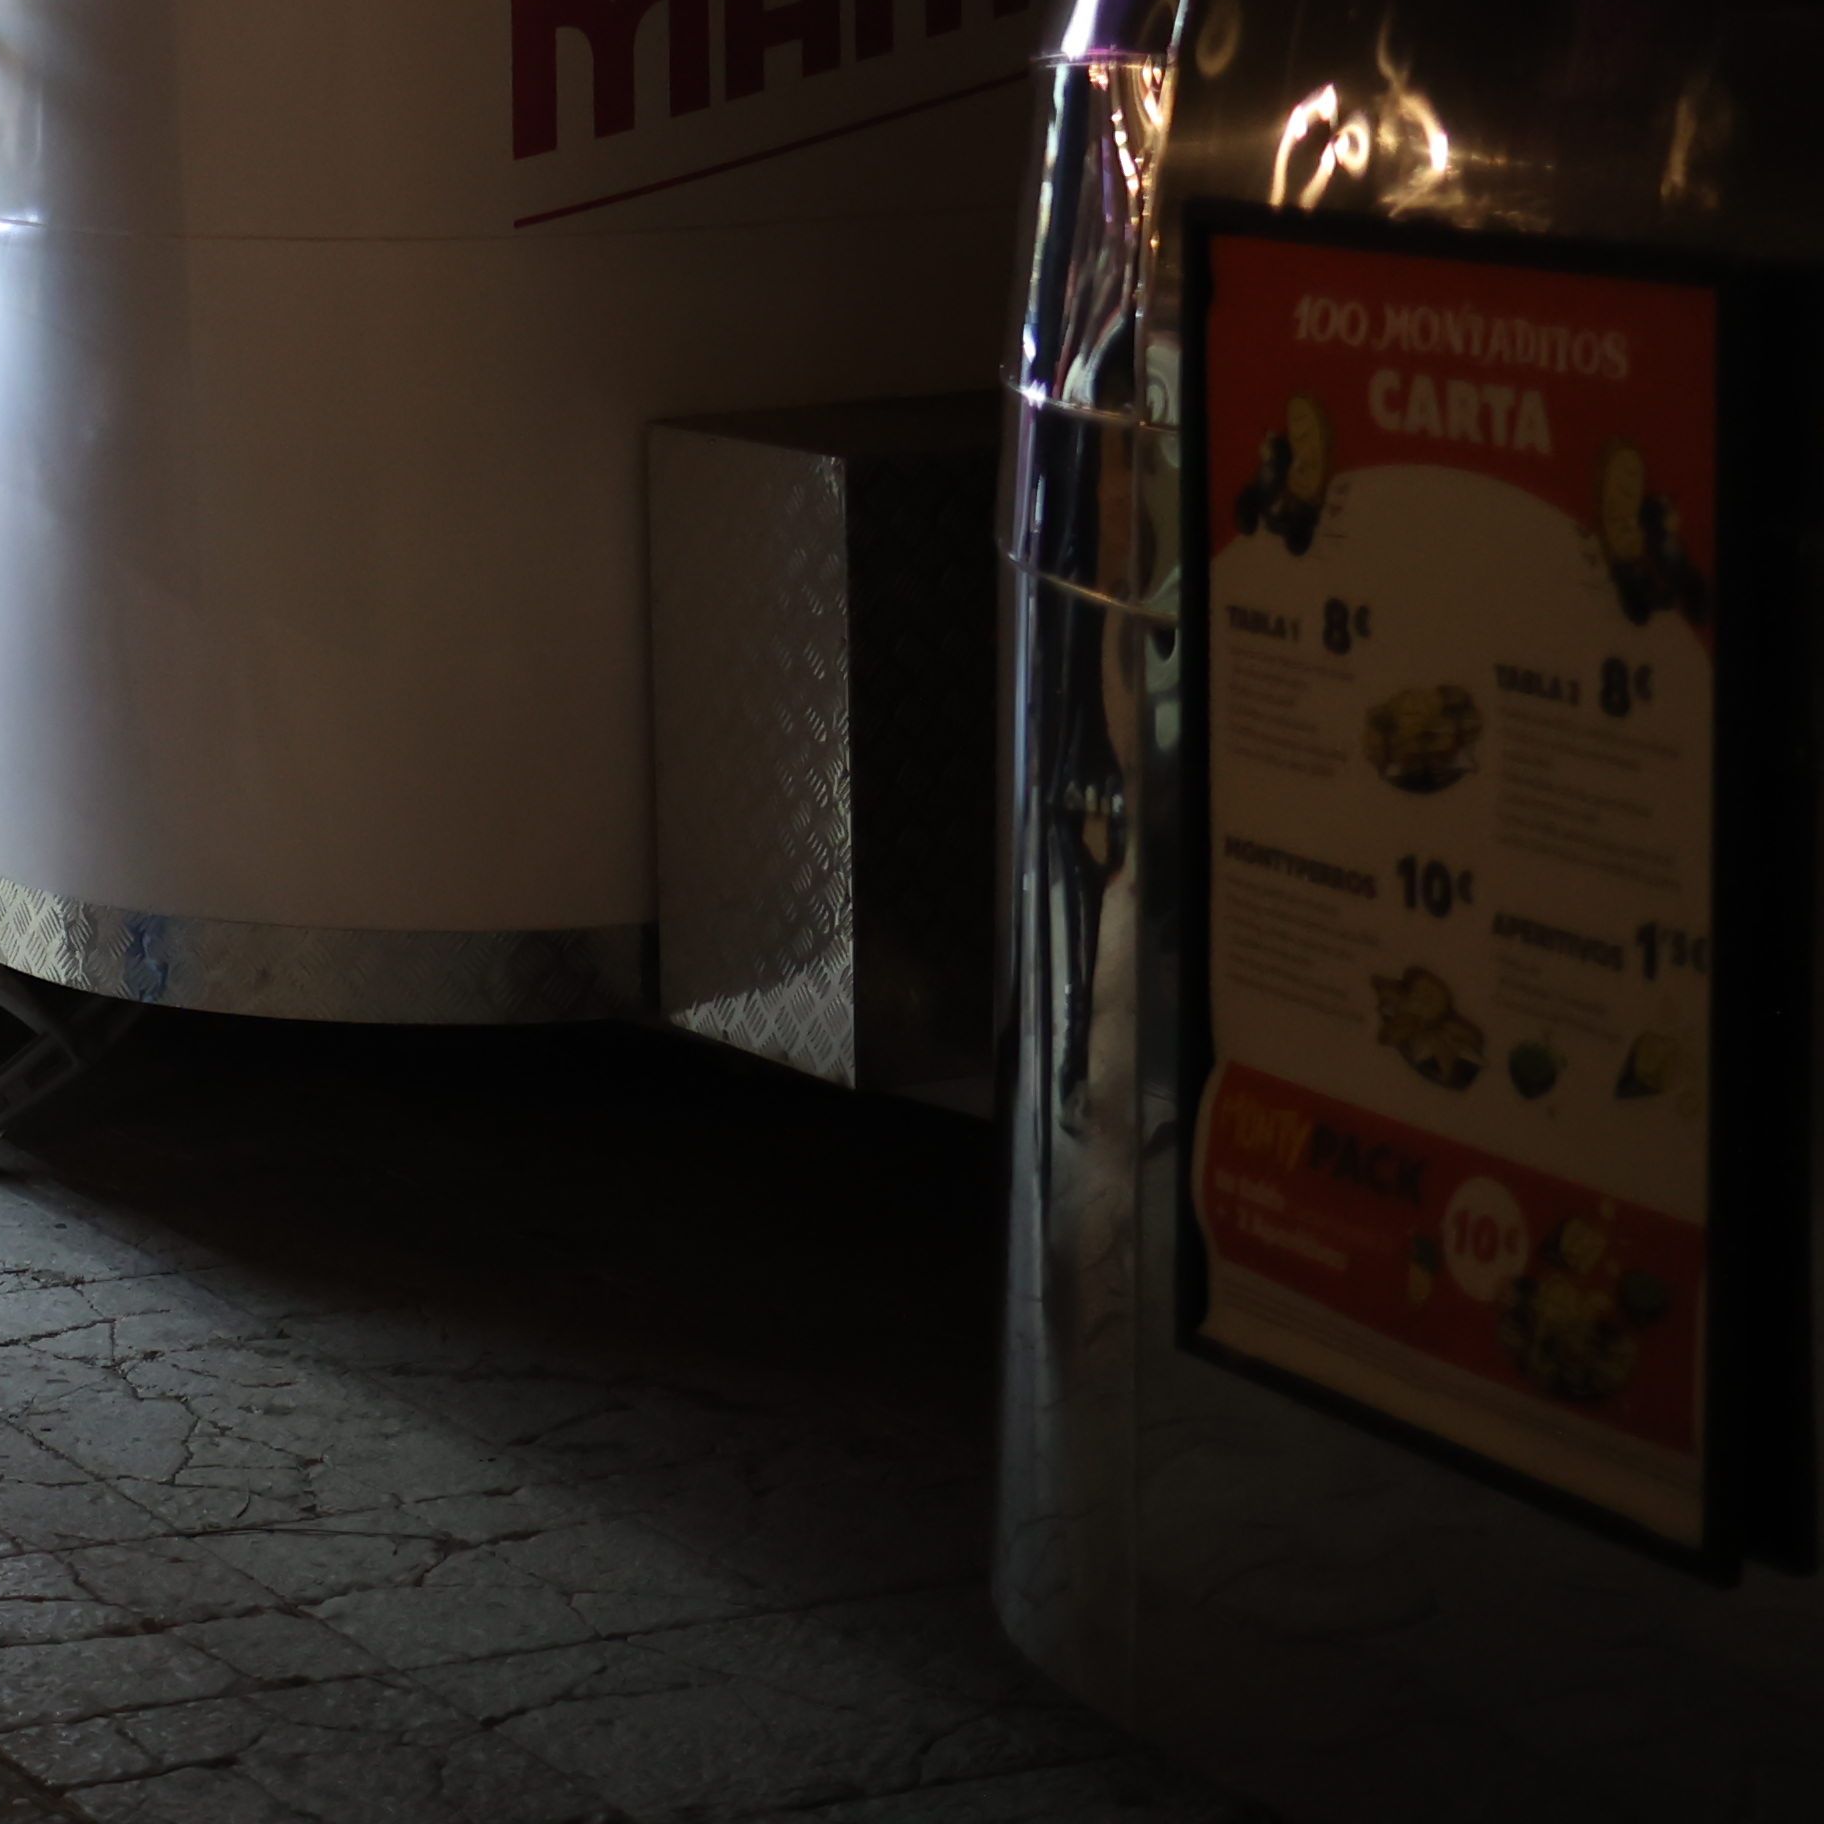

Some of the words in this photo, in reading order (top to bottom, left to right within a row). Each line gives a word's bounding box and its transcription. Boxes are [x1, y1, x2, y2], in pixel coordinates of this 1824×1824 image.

[1292, 293, 1369, 349] 100
[1372, 301, 1632, 381] MONTADITOS
[1366, 367, 1555, 457] CARTA
